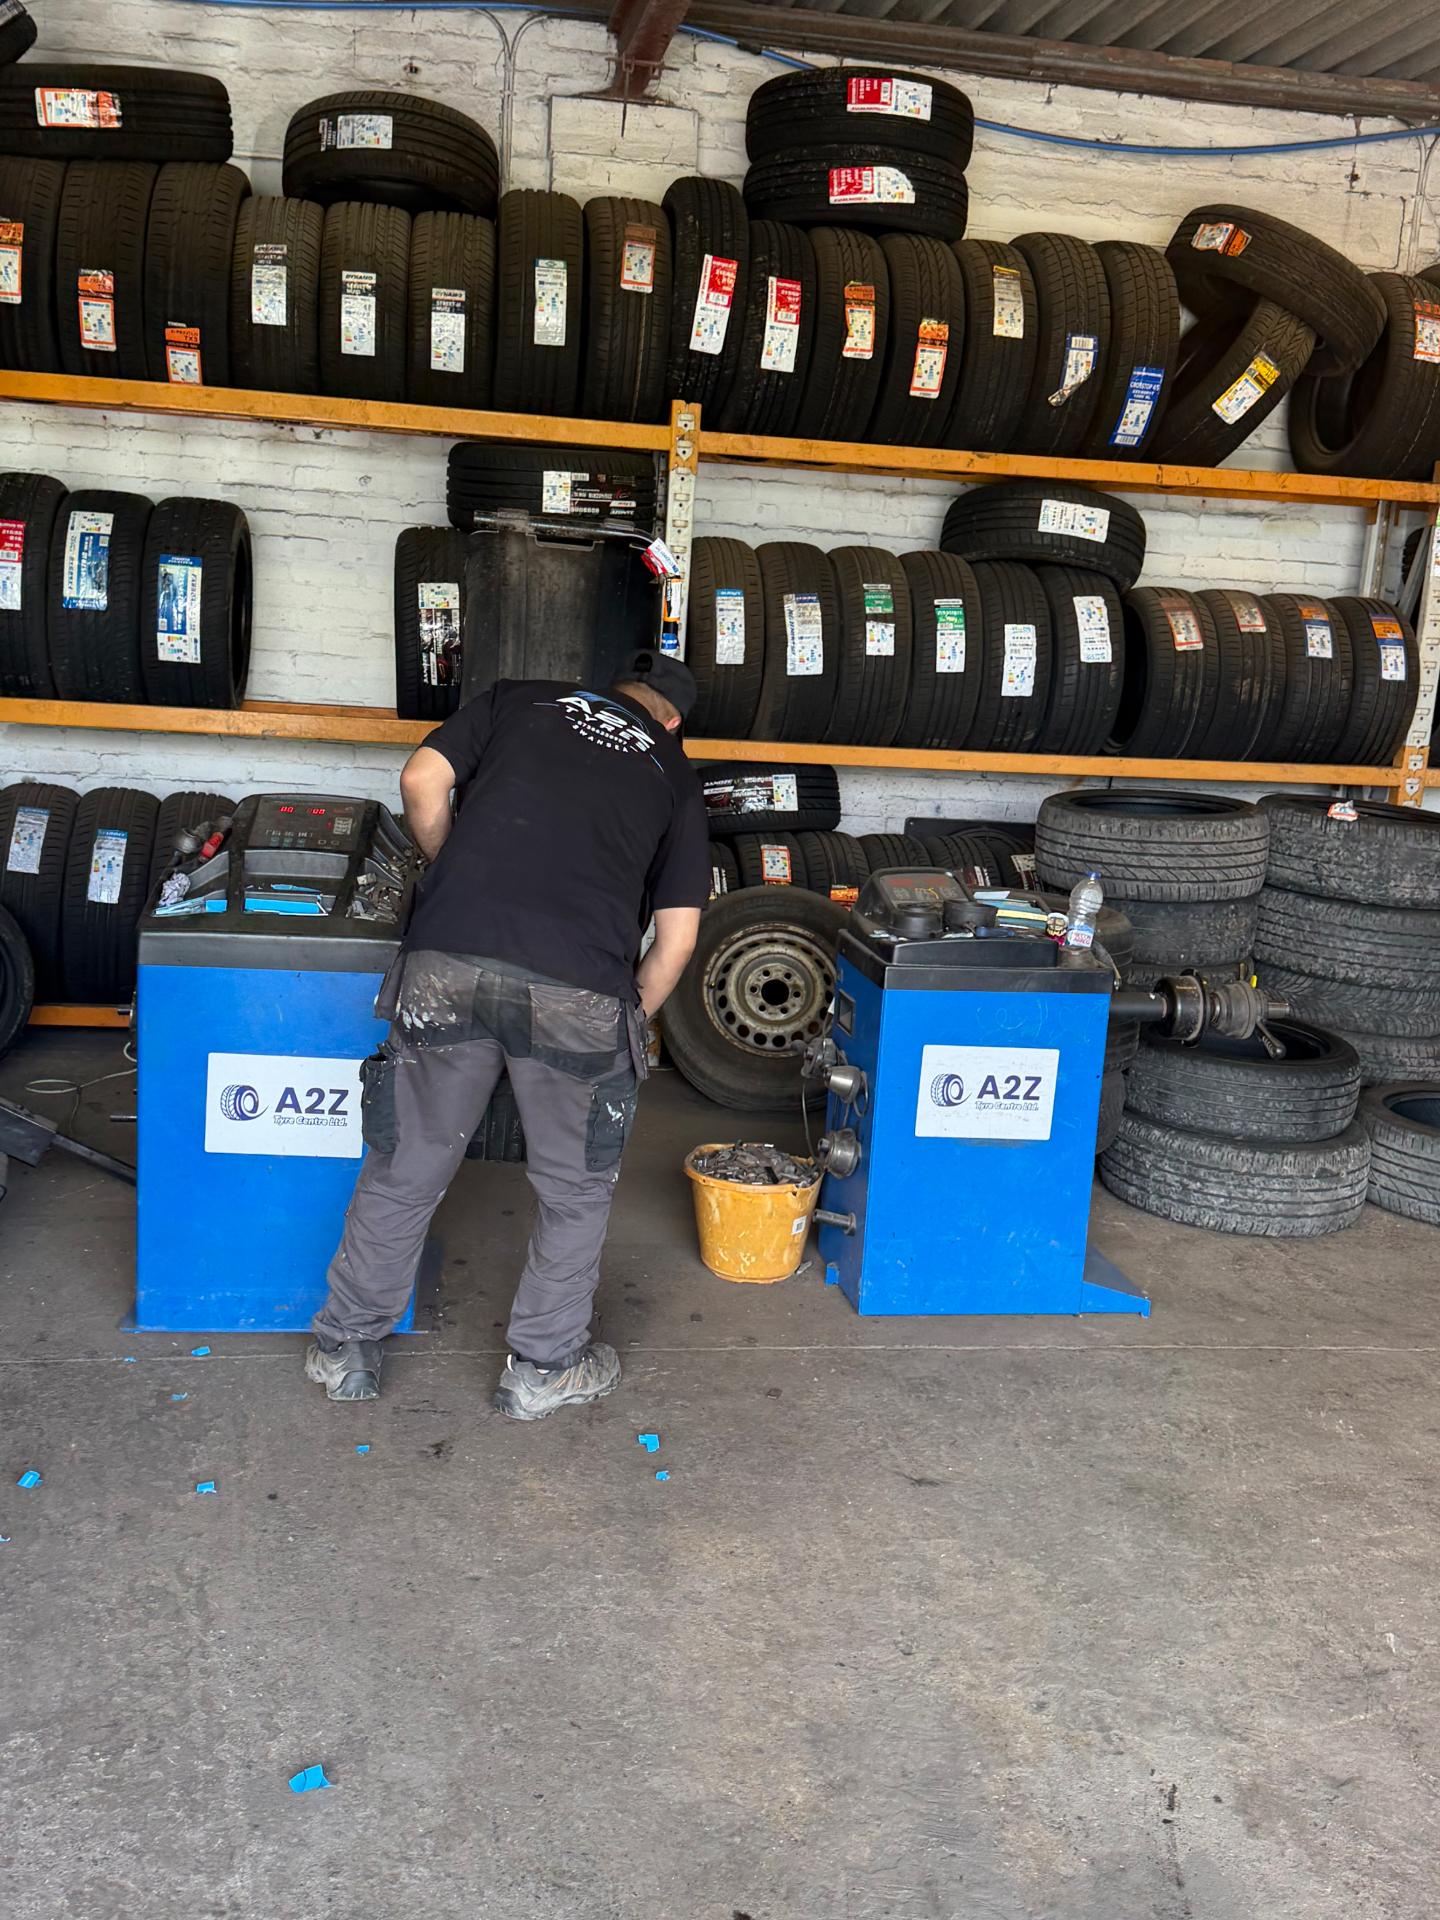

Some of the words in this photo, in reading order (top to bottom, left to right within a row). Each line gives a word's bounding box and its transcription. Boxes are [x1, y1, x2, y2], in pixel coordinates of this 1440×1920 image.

[556, 697, 655, 749] A2Z
[566, 705, 648, 752] TYRES
[572, 724, 629, 753] SWANSEA
[274, 1086, 349, 1116] A2Z
[977, 1075, 1042, 1101] A2Z
[975, 1101, 994, 1111] Tyre
[994, 1101, 1022, 1111] Centre
[1022, 1102, 1040, 1111] Ltd.
[273, 1114, 296, 1126] Tyre
[295, 1115, 328, 1128] Centre
[328, 1117, 348, 1127] Ltd.
